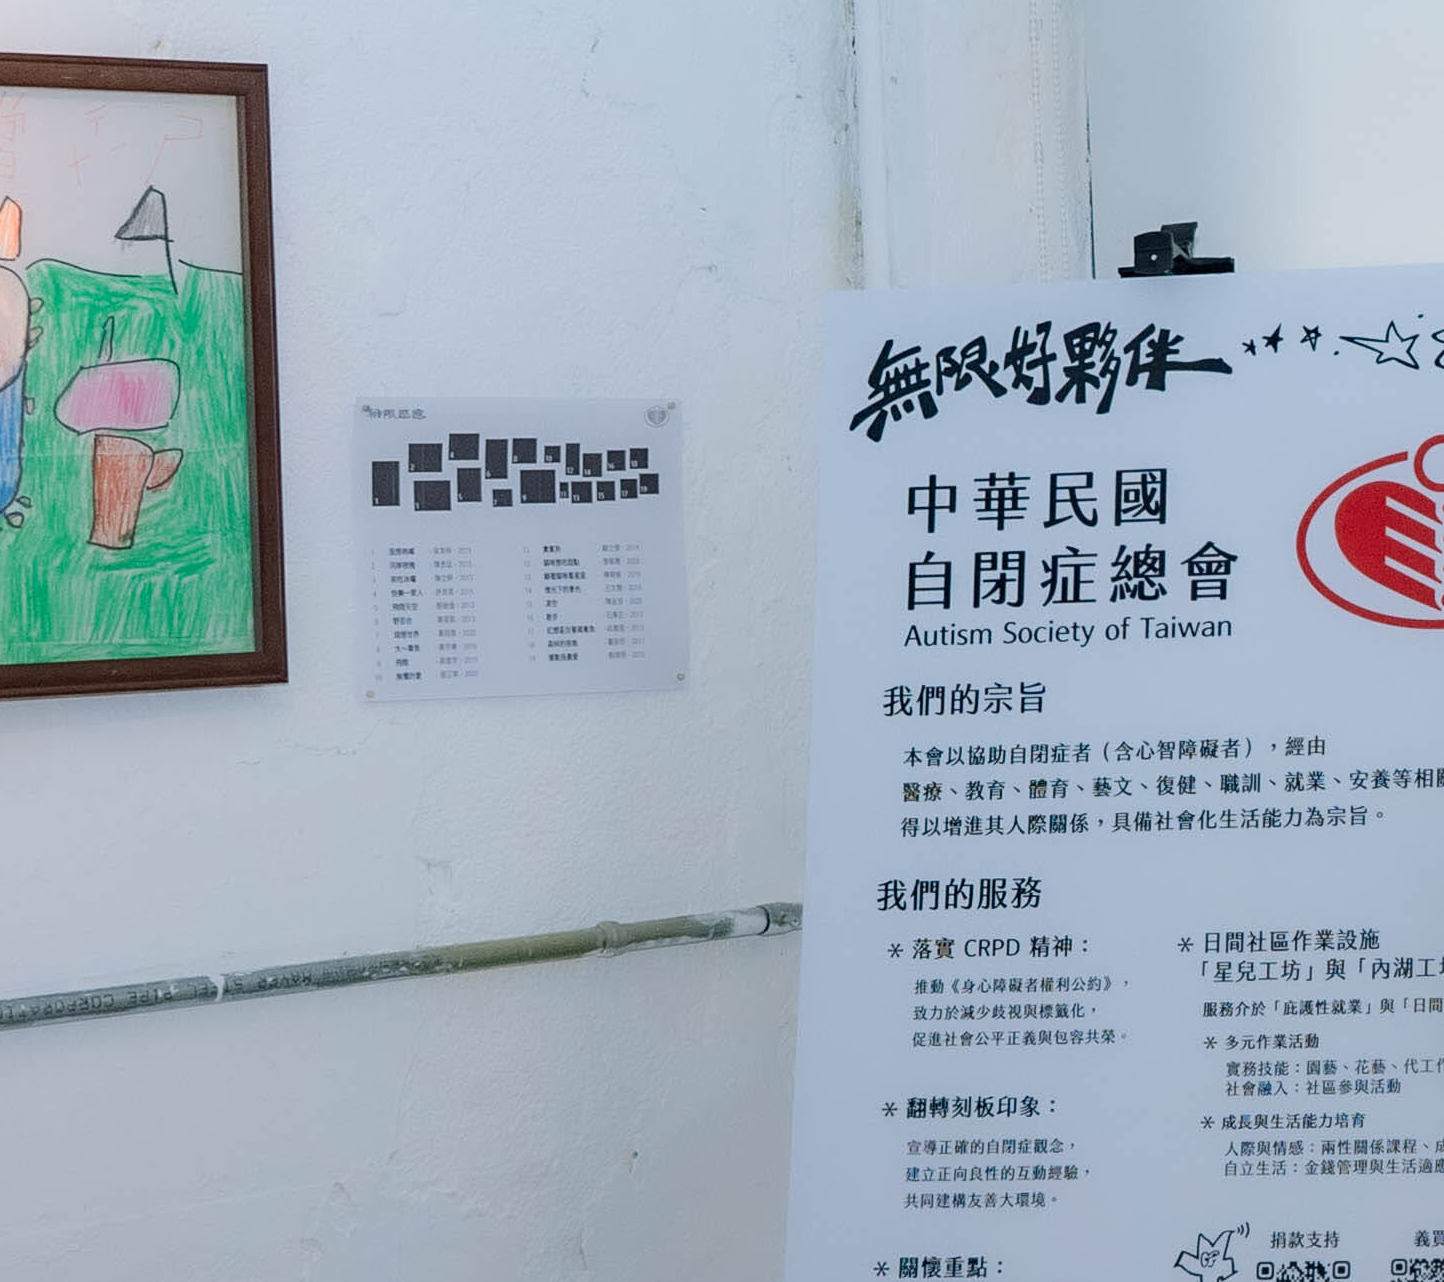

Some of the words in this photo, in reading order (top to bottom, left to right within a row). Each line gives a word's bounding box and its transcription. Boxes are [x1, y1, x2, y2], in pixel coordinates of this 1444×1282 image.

[849, 320, 1233, 443] 無限好夥伴
[908, 468, 1167, 534] 中華民國
[907, 541, 1238, 611] 自閉症總會
[904, 623, 992, 647] Autism
[1003, 620, 1095, 648] Society
[1105, 616, 1131, 641] of
[1140, 616, 1232, 639] Taiwan
[883, 681, 1046, 717] 我們的宗旨
[877, 876, 1042, 911] 我們的服務
[912, 937, 955, 960] 落實
[964, 936, 1020, 957] CRPD
[1205, 928, 1380, 954] 日間社區作業設施
[1226, 1033, 1319, 1051] 多元作業活動
[1221, 1112, 1366, 1130] 成長與生活能力培育
[1270, 1230, 1340, 1249] 捐款支持
